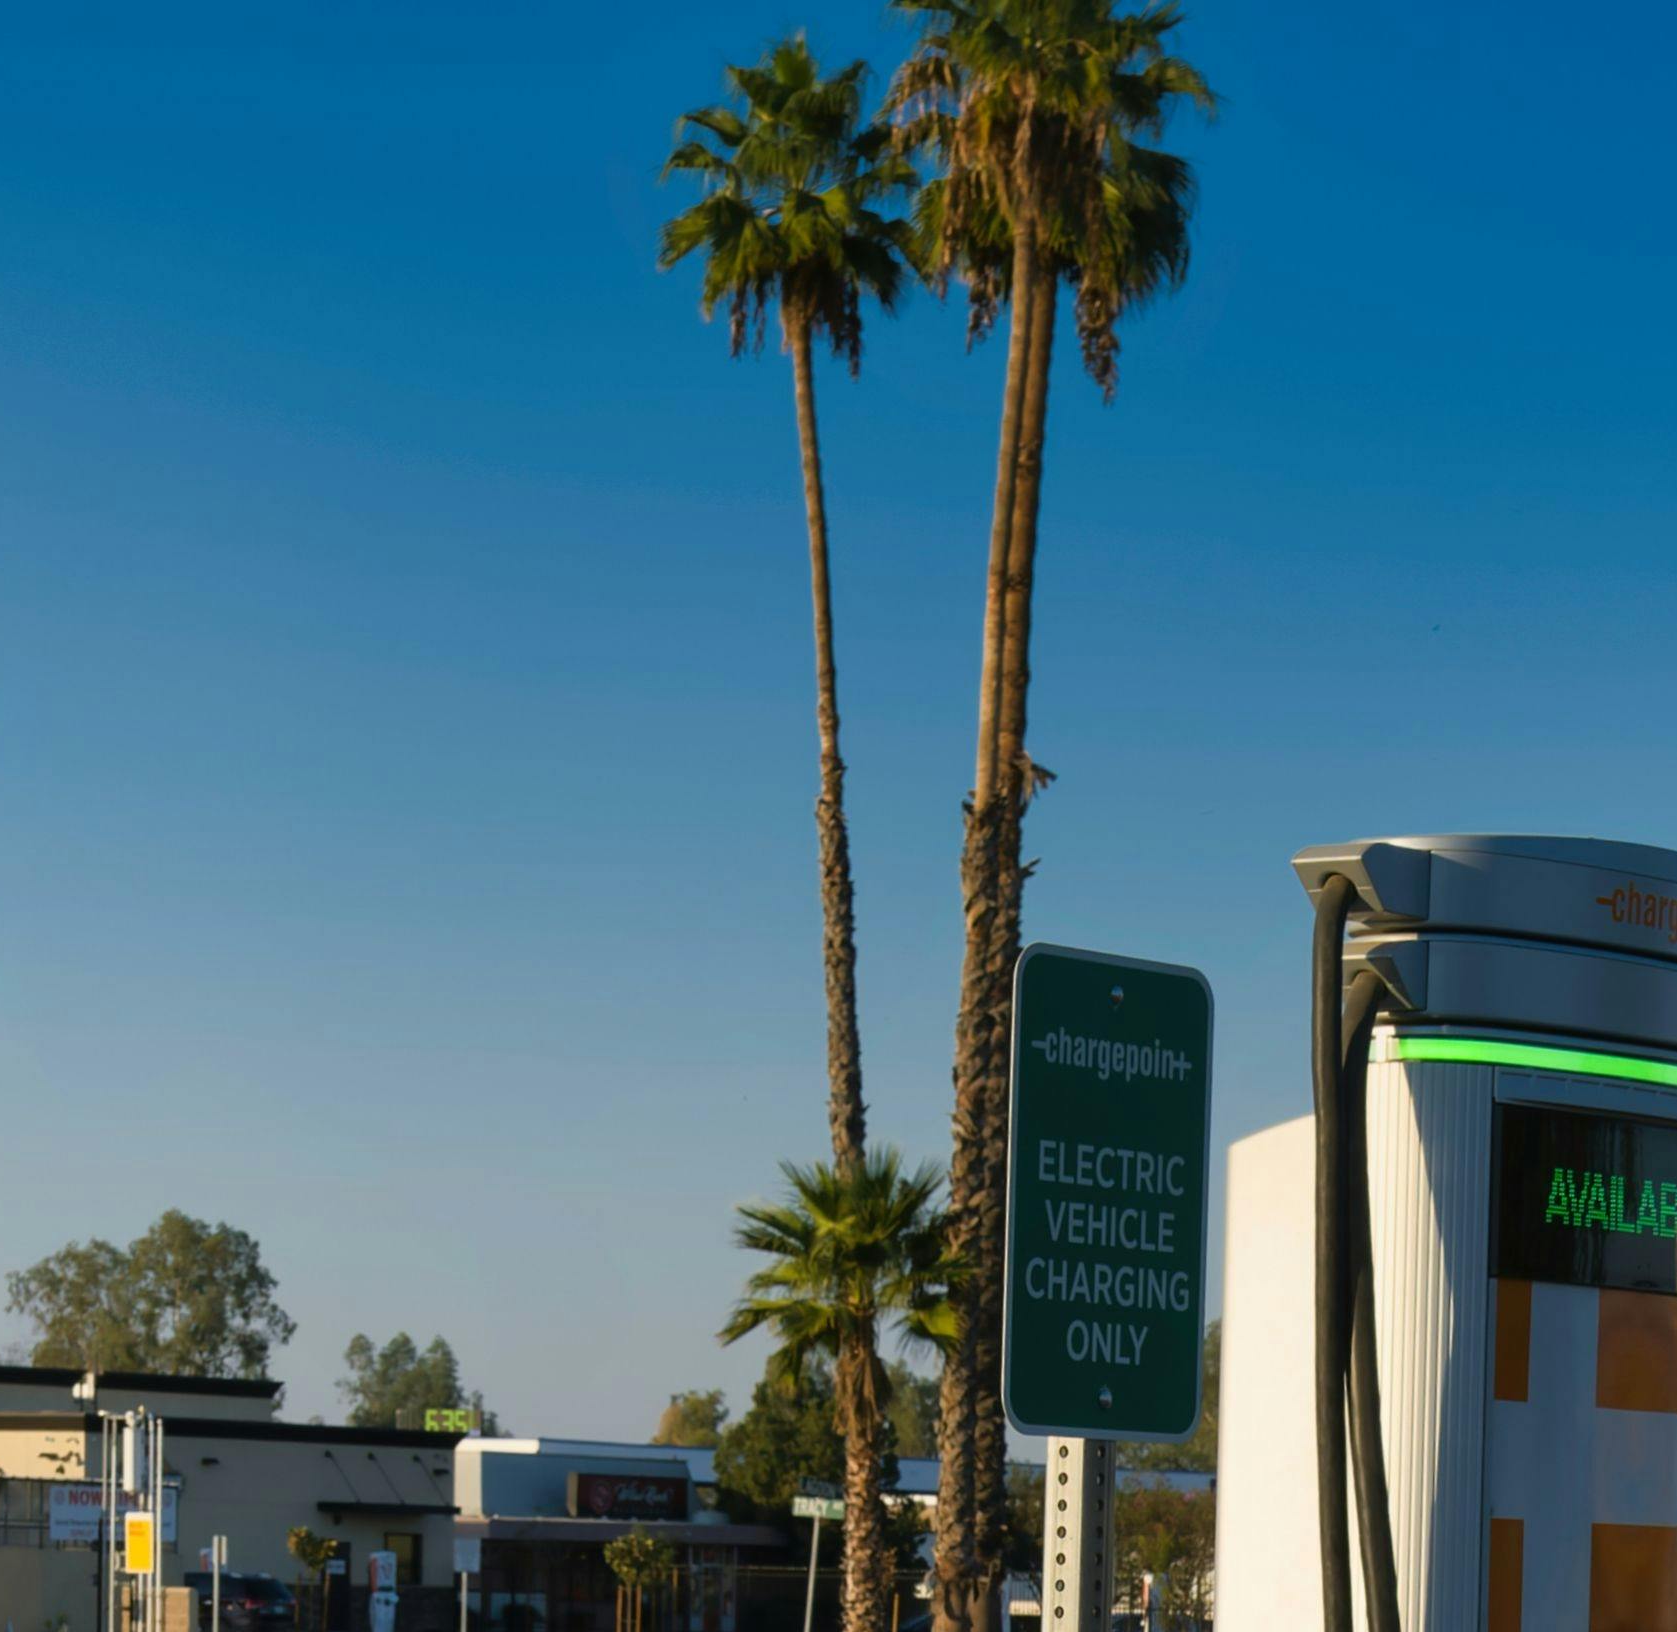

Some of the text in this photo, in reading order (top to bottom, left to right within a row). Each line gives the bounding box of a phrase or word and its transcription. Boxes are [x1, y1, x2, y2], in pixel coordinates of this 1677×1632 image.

[1038, 1139, 1185, 1196] ELECTRIC
[1045, 1200, 1175, 1254] VEHICLE
[1025, 1257, 1190, 1312] CHARGING
[1066, 1318, 1149, 1367] ONLY
